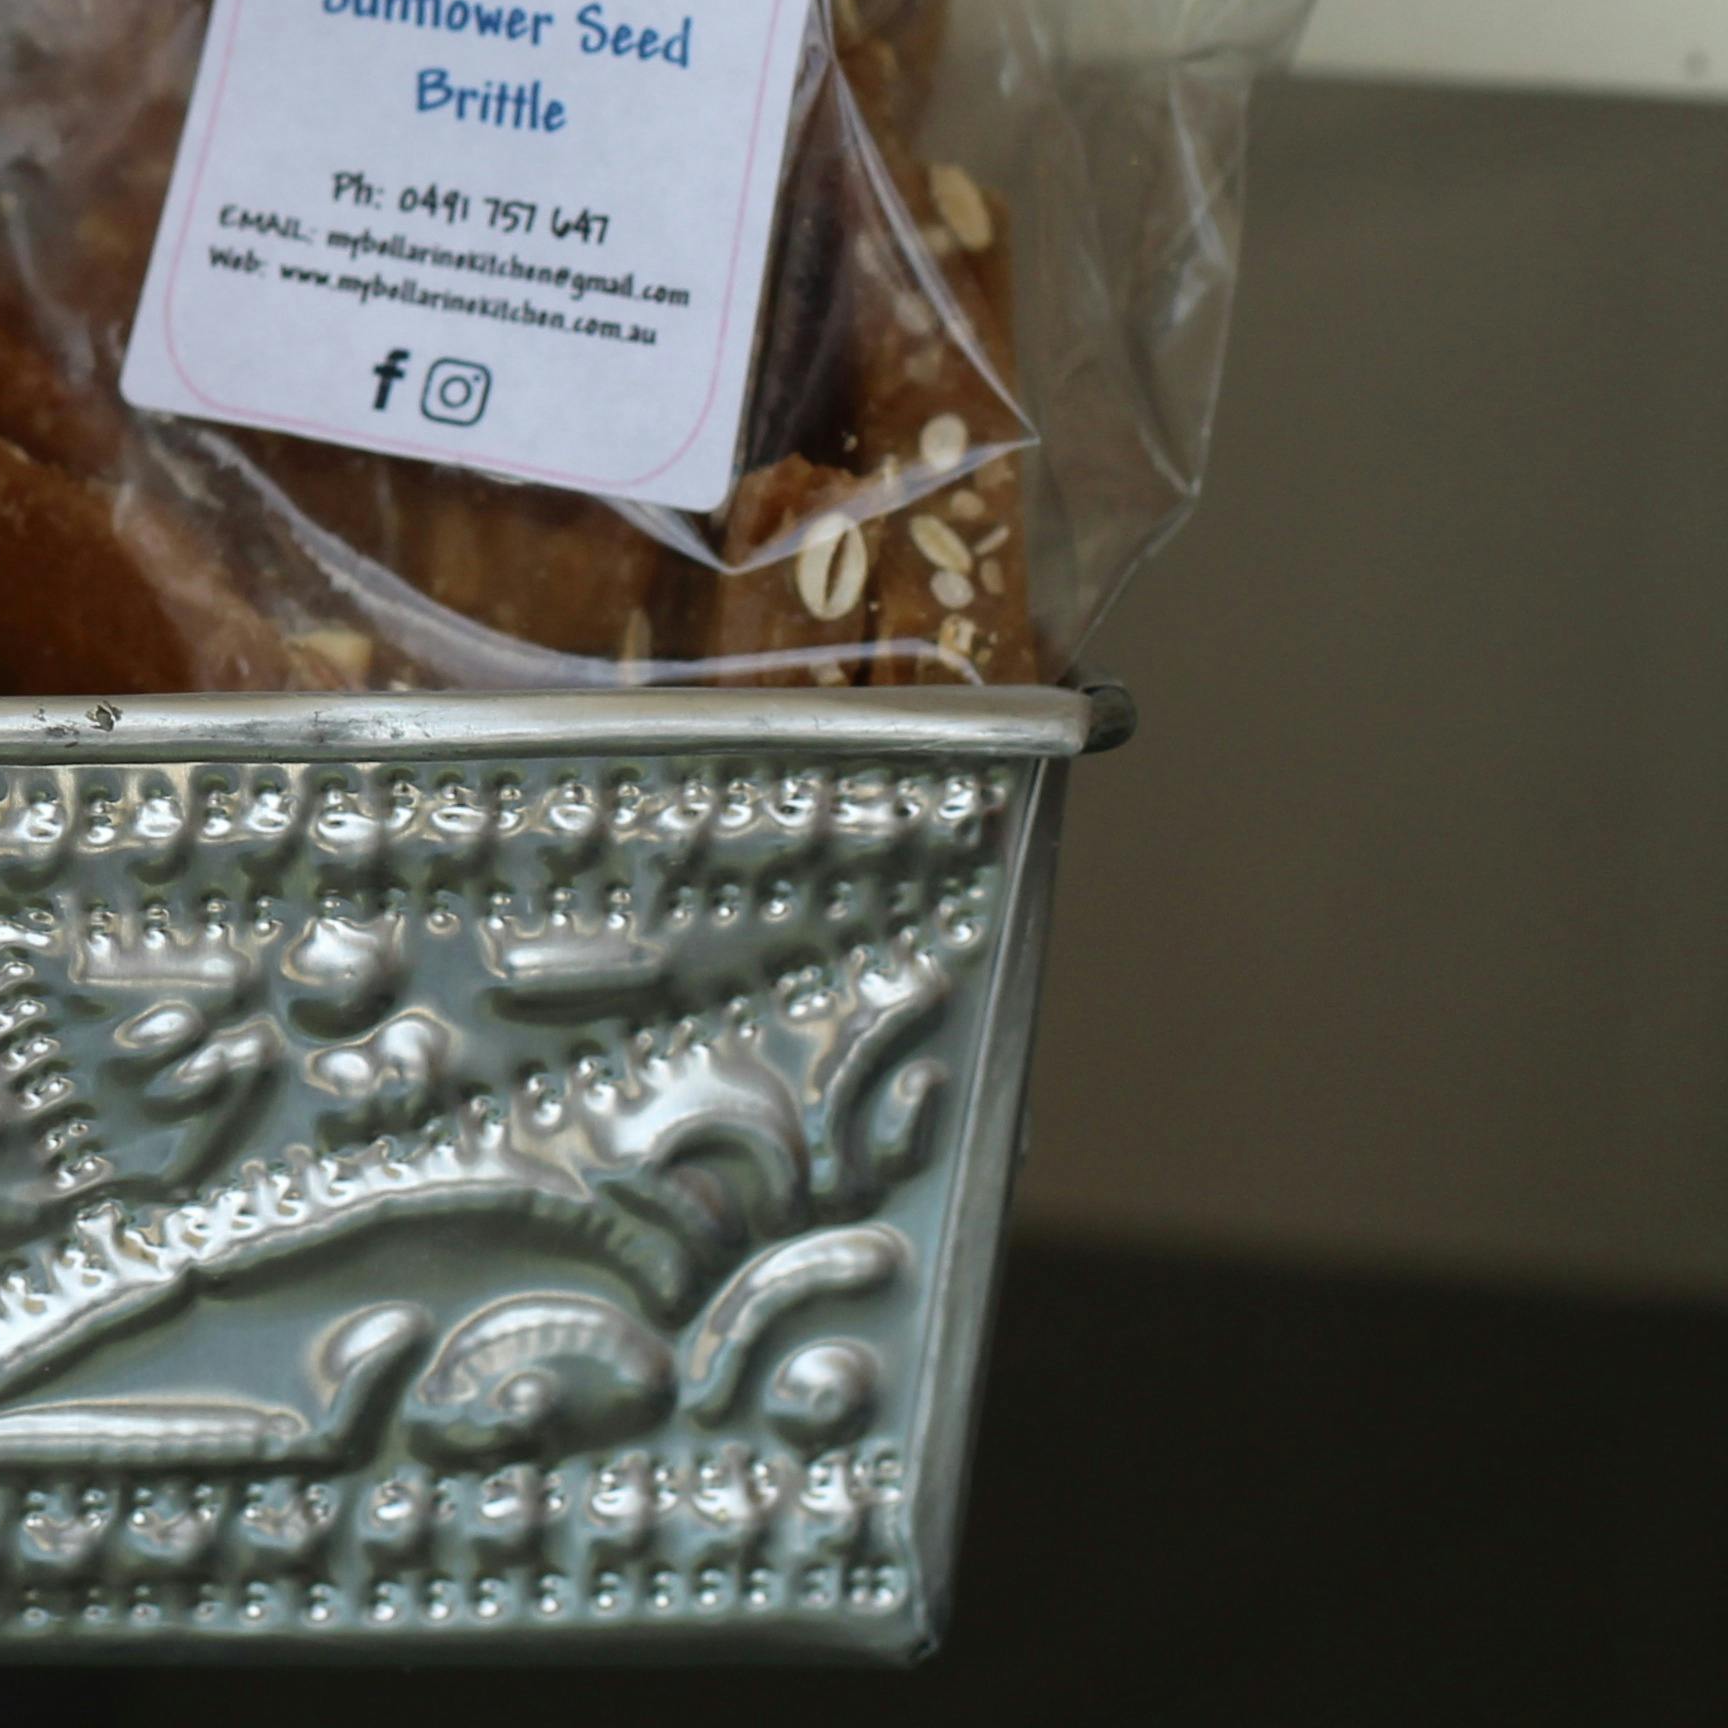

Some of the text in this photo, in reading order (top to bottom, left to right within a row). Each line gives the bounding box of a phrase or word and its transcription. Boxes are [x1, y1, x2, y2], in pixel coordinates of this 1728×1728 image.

[576, 3, 691, 68] Seed
[417, 69, 565, 132] Brittle
[218, 205, 315, 242] EMAIL:
[333, 171, 609, 243] Ph: 0491 757 647
[209, 246, 266, 273] Web:
